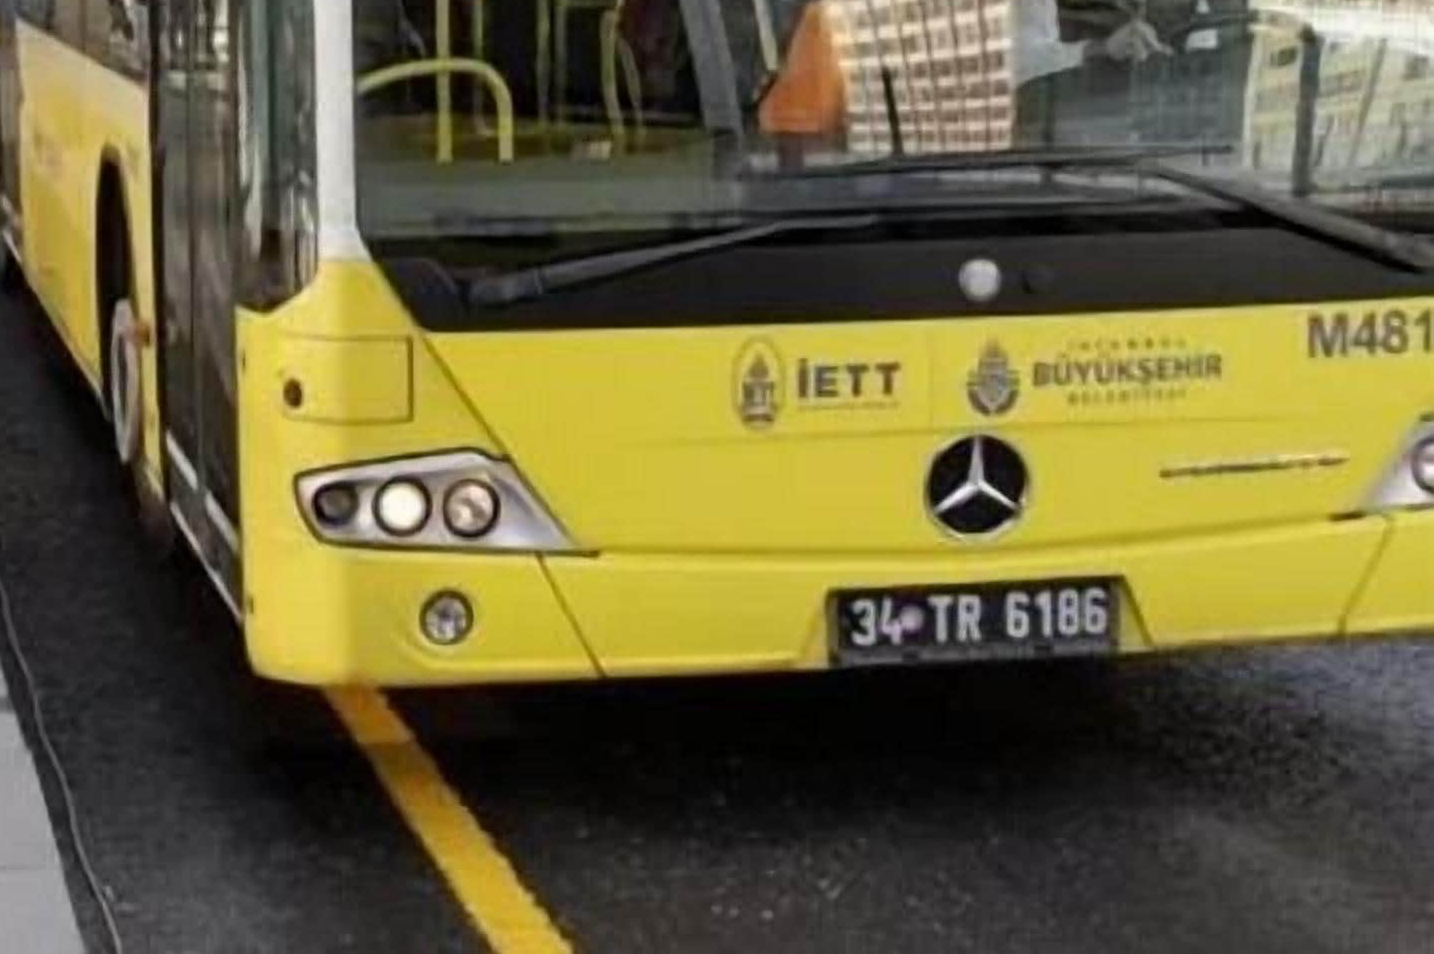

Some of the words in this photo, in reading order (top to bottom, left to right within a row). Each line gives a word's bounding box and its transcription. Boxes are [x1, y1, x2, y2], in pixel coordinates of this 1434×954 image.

[797, 358, 901, 398] İETT
[851, 597, 903, 646] 34
[927, 594, 982, 642] TR
[1006, 587, 1108, 639] 6186
